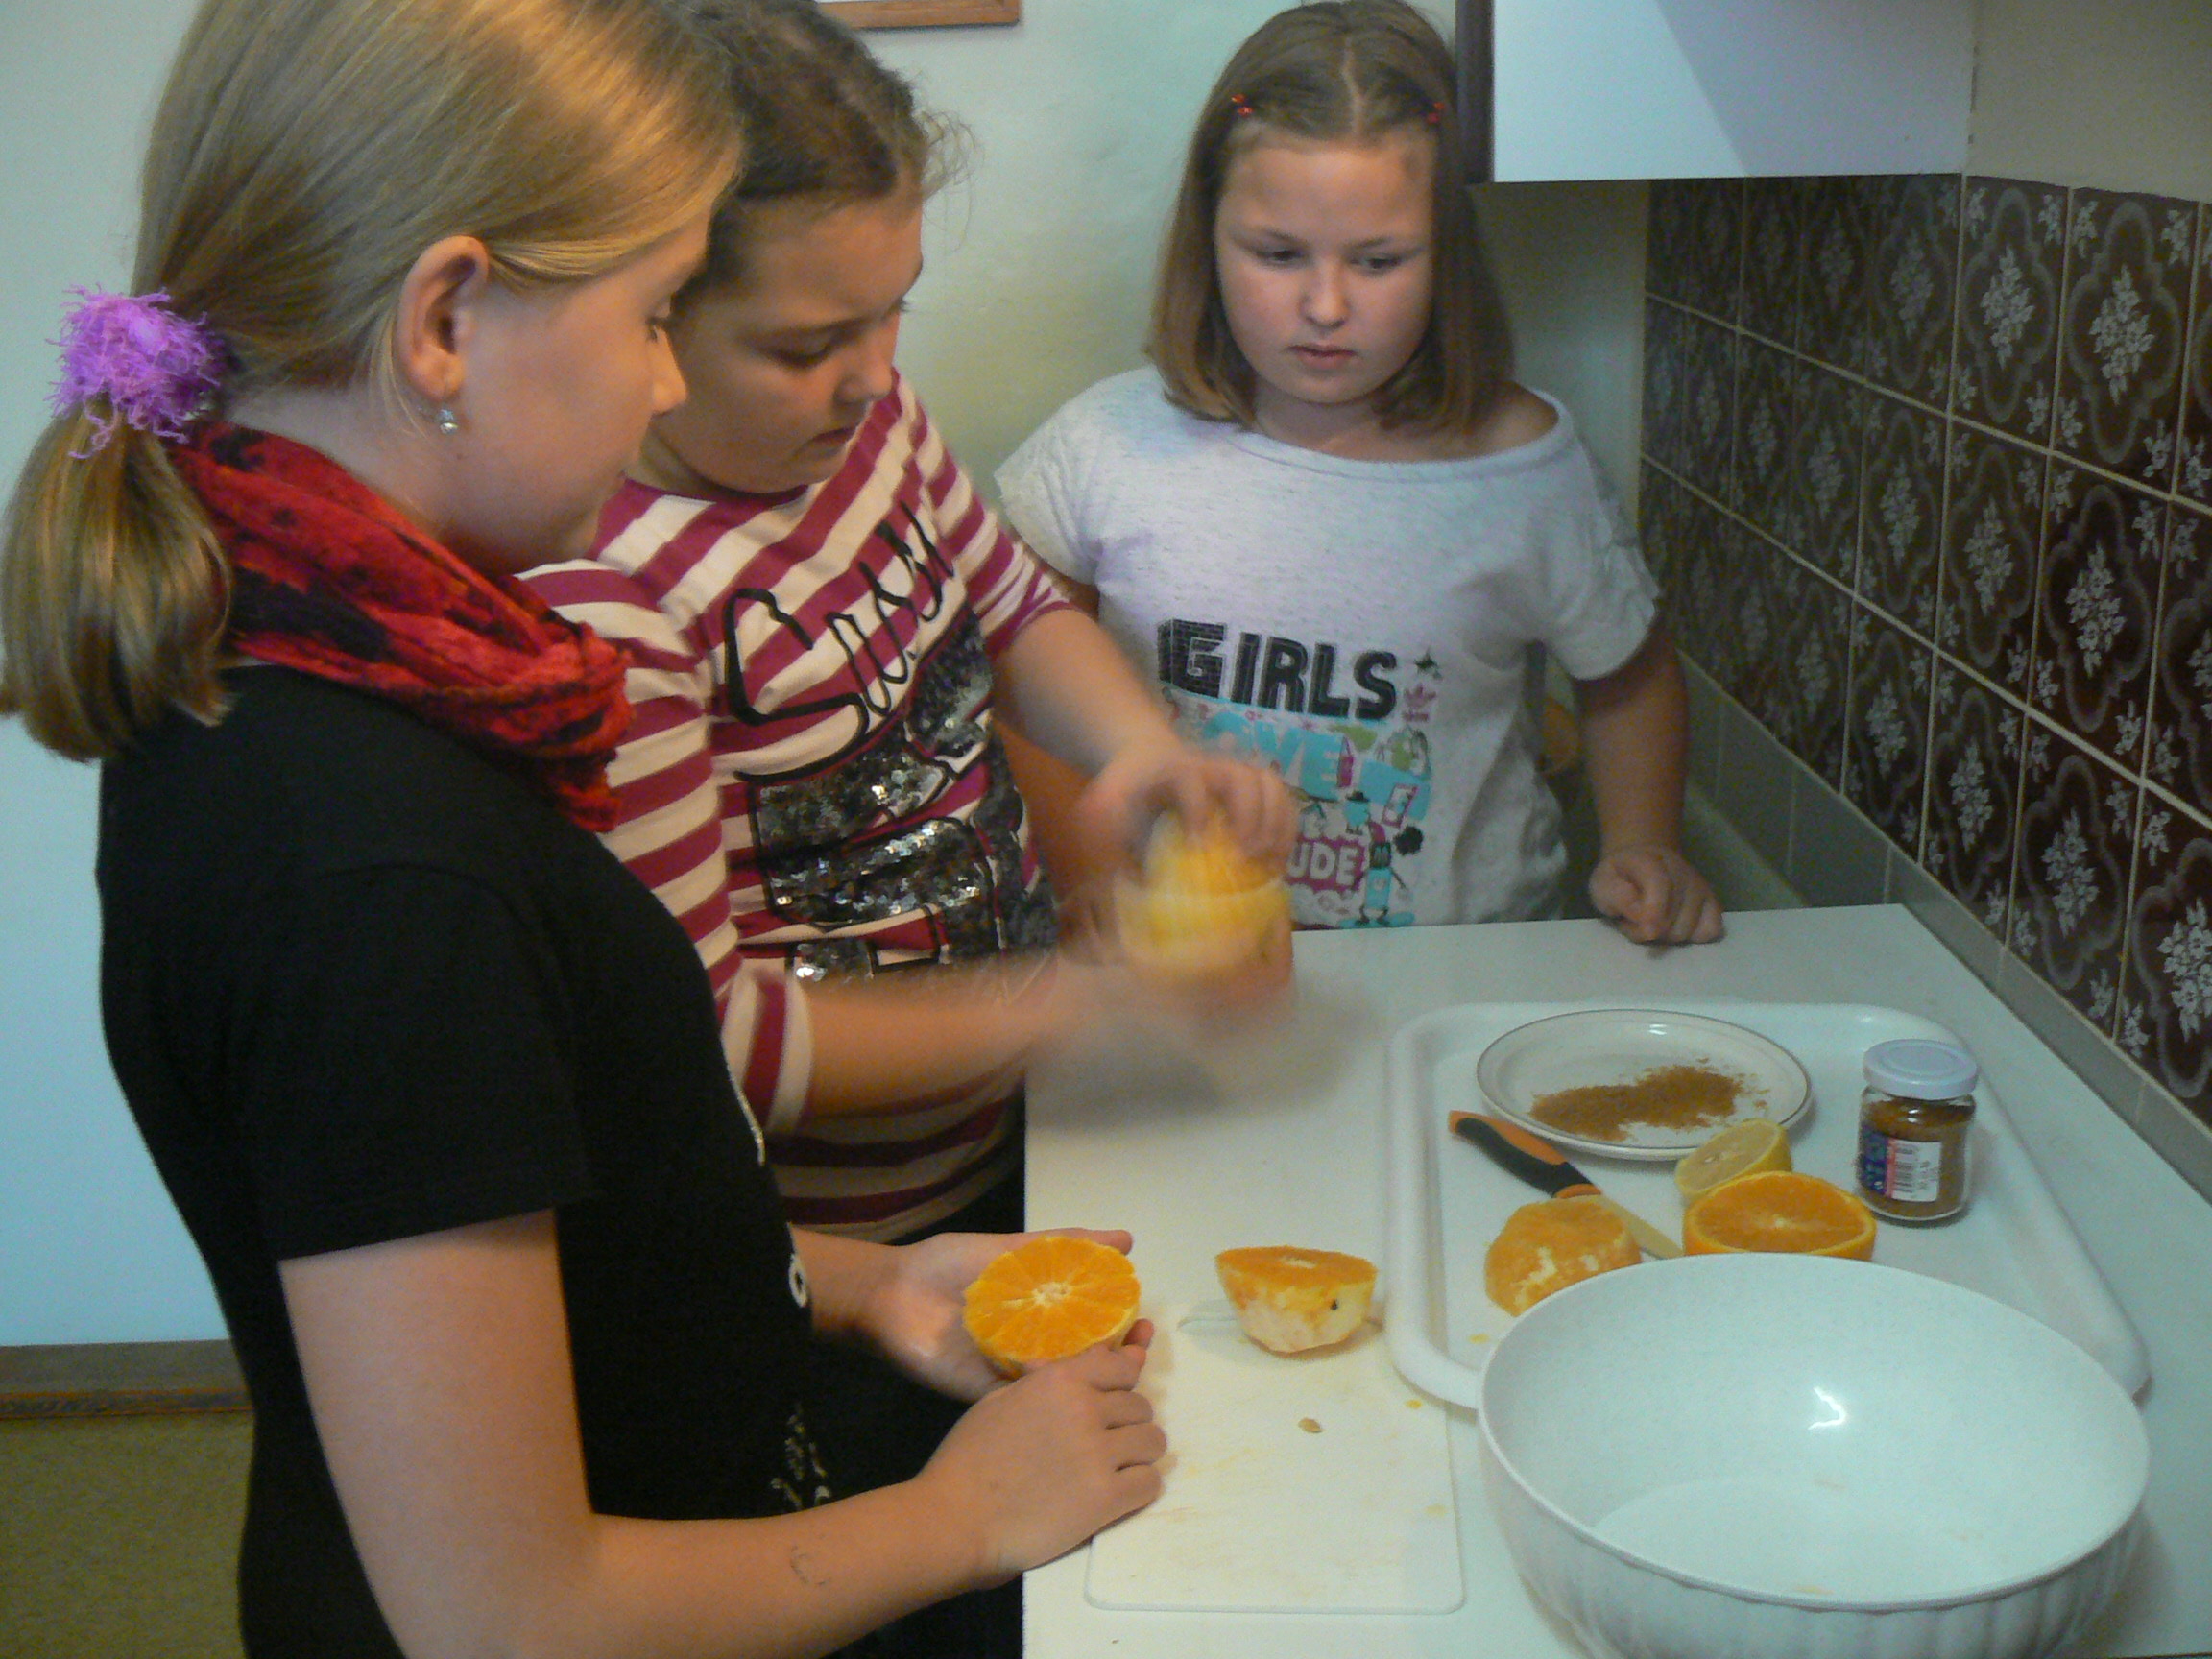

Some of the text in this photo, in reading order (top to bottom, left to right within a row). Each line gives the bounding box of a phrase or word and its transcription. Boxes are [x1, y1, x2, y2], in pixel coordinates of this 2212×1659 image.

[1158, 618, 1397, 721] GIRLS
[1181, 710, 1346, 802] OVE
[1287, 841, 1360, 888] UDE
